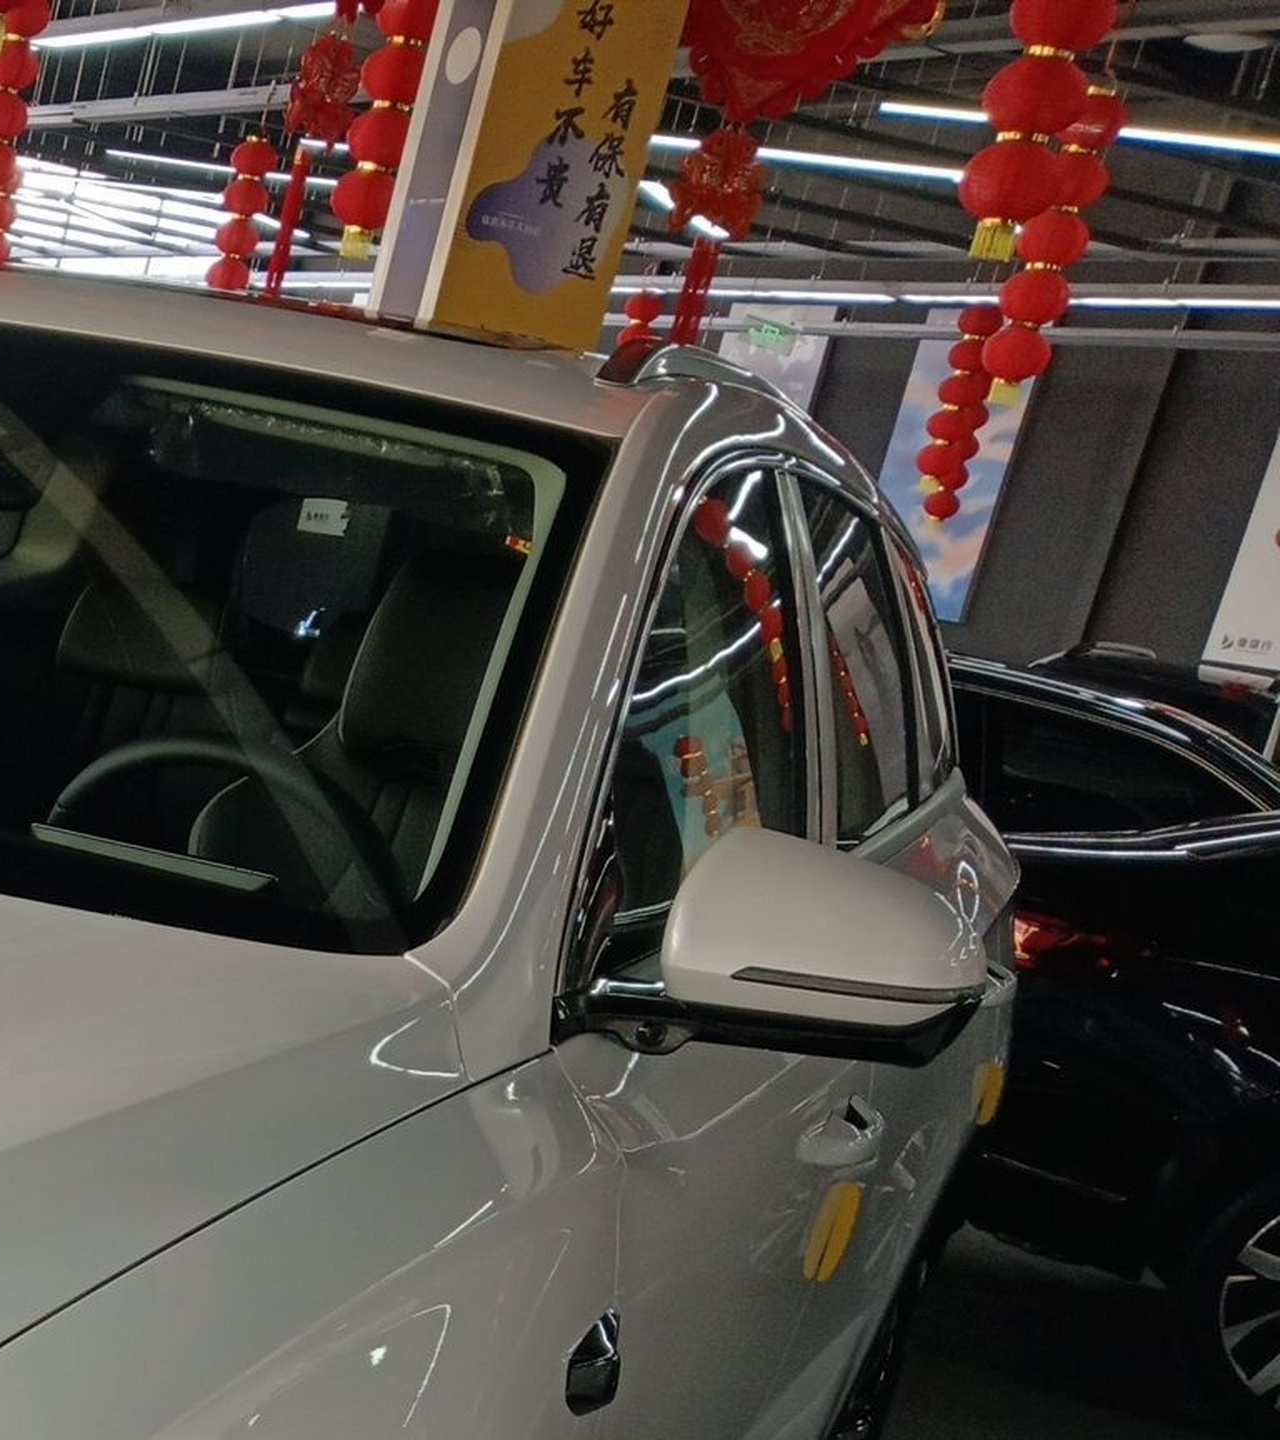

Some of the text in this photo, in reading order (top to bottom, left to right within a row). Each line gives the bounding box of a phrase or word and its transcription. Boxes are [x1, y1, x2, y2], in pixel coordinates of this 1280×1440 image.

[535, 1, 615, 209] 好车不贵
[561, 78, 639, 281] 有保有退
